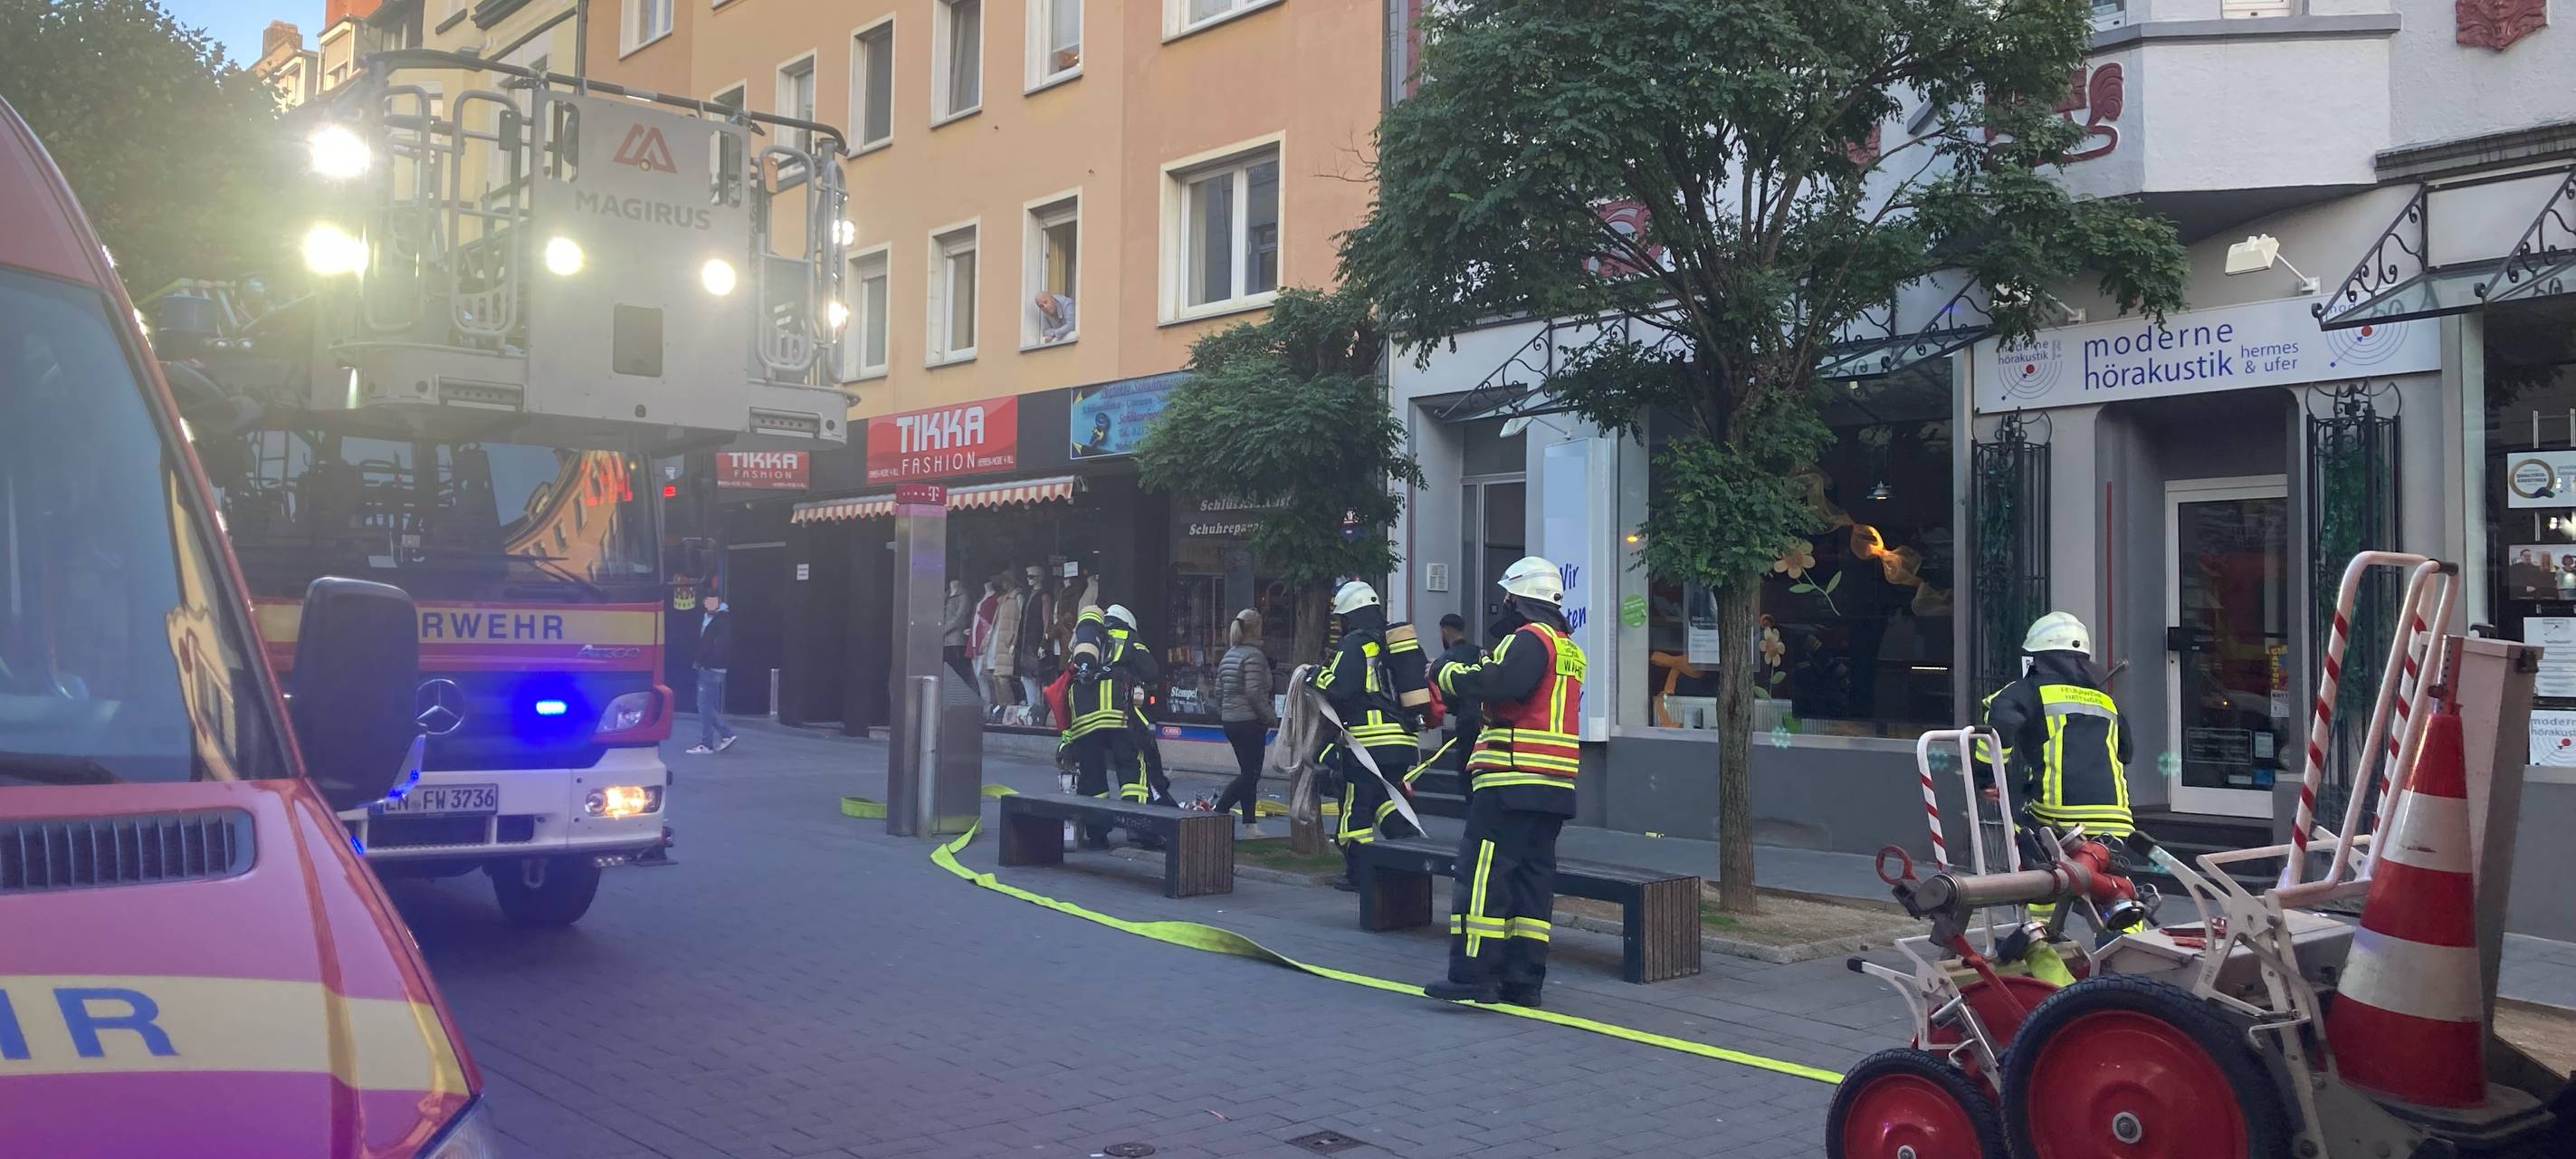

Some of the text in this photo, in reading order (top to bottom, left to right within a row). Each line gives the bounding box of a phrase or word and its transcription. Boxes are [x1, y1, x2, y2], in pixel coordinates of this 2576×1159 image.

[574, 190, 711, 231] MAGIRUS
[2085, 323, 2234, 358] moderne
[2240, 341, 2300, 359] hermes
[1998, 350, 2049, 365] hörakustik
[2244, 358, 2299, 375] & ufer
[2085, 350, 2234, 390] hörakustik
[896, 406, 985, 454] TIKKA
[727, 452, 797, 470] TIKKA
[902, 452, 976, 476] FASHION
[734, 470, 792, 479] FASHION
[421, 611, 563, 639] RWEHR
[1170, 686, 1198, 700] Stempel
[423, 790, 446, 809] FW
[451, 789, 495, 809] 3736
